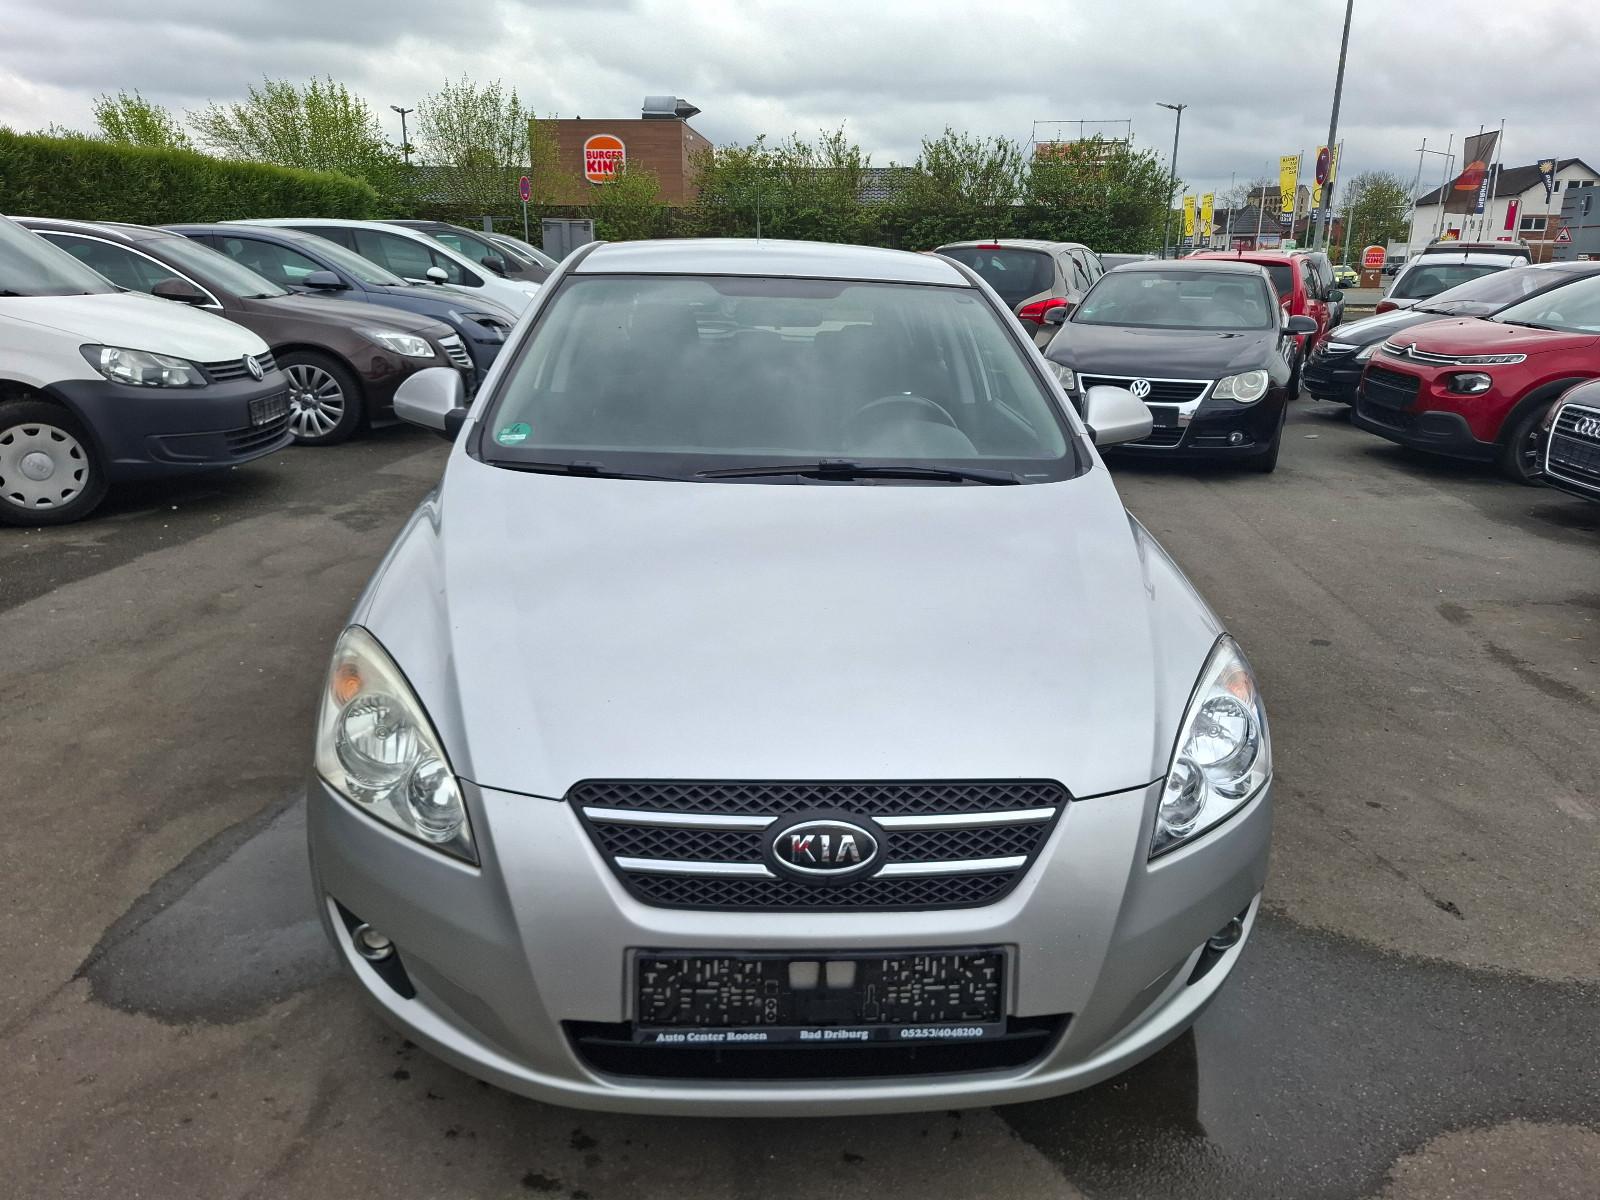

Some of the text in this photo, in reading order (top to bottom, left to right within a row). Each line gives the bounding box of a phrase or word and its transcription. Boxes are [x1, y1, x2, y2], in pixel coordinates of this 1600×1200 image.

[586, 150, 623, 159] BURGER
[790, 834, 861, 862] KIA
[656, 1027, 984, 1042] Auto Center Roosen Bad Driburg 05253/4048200
